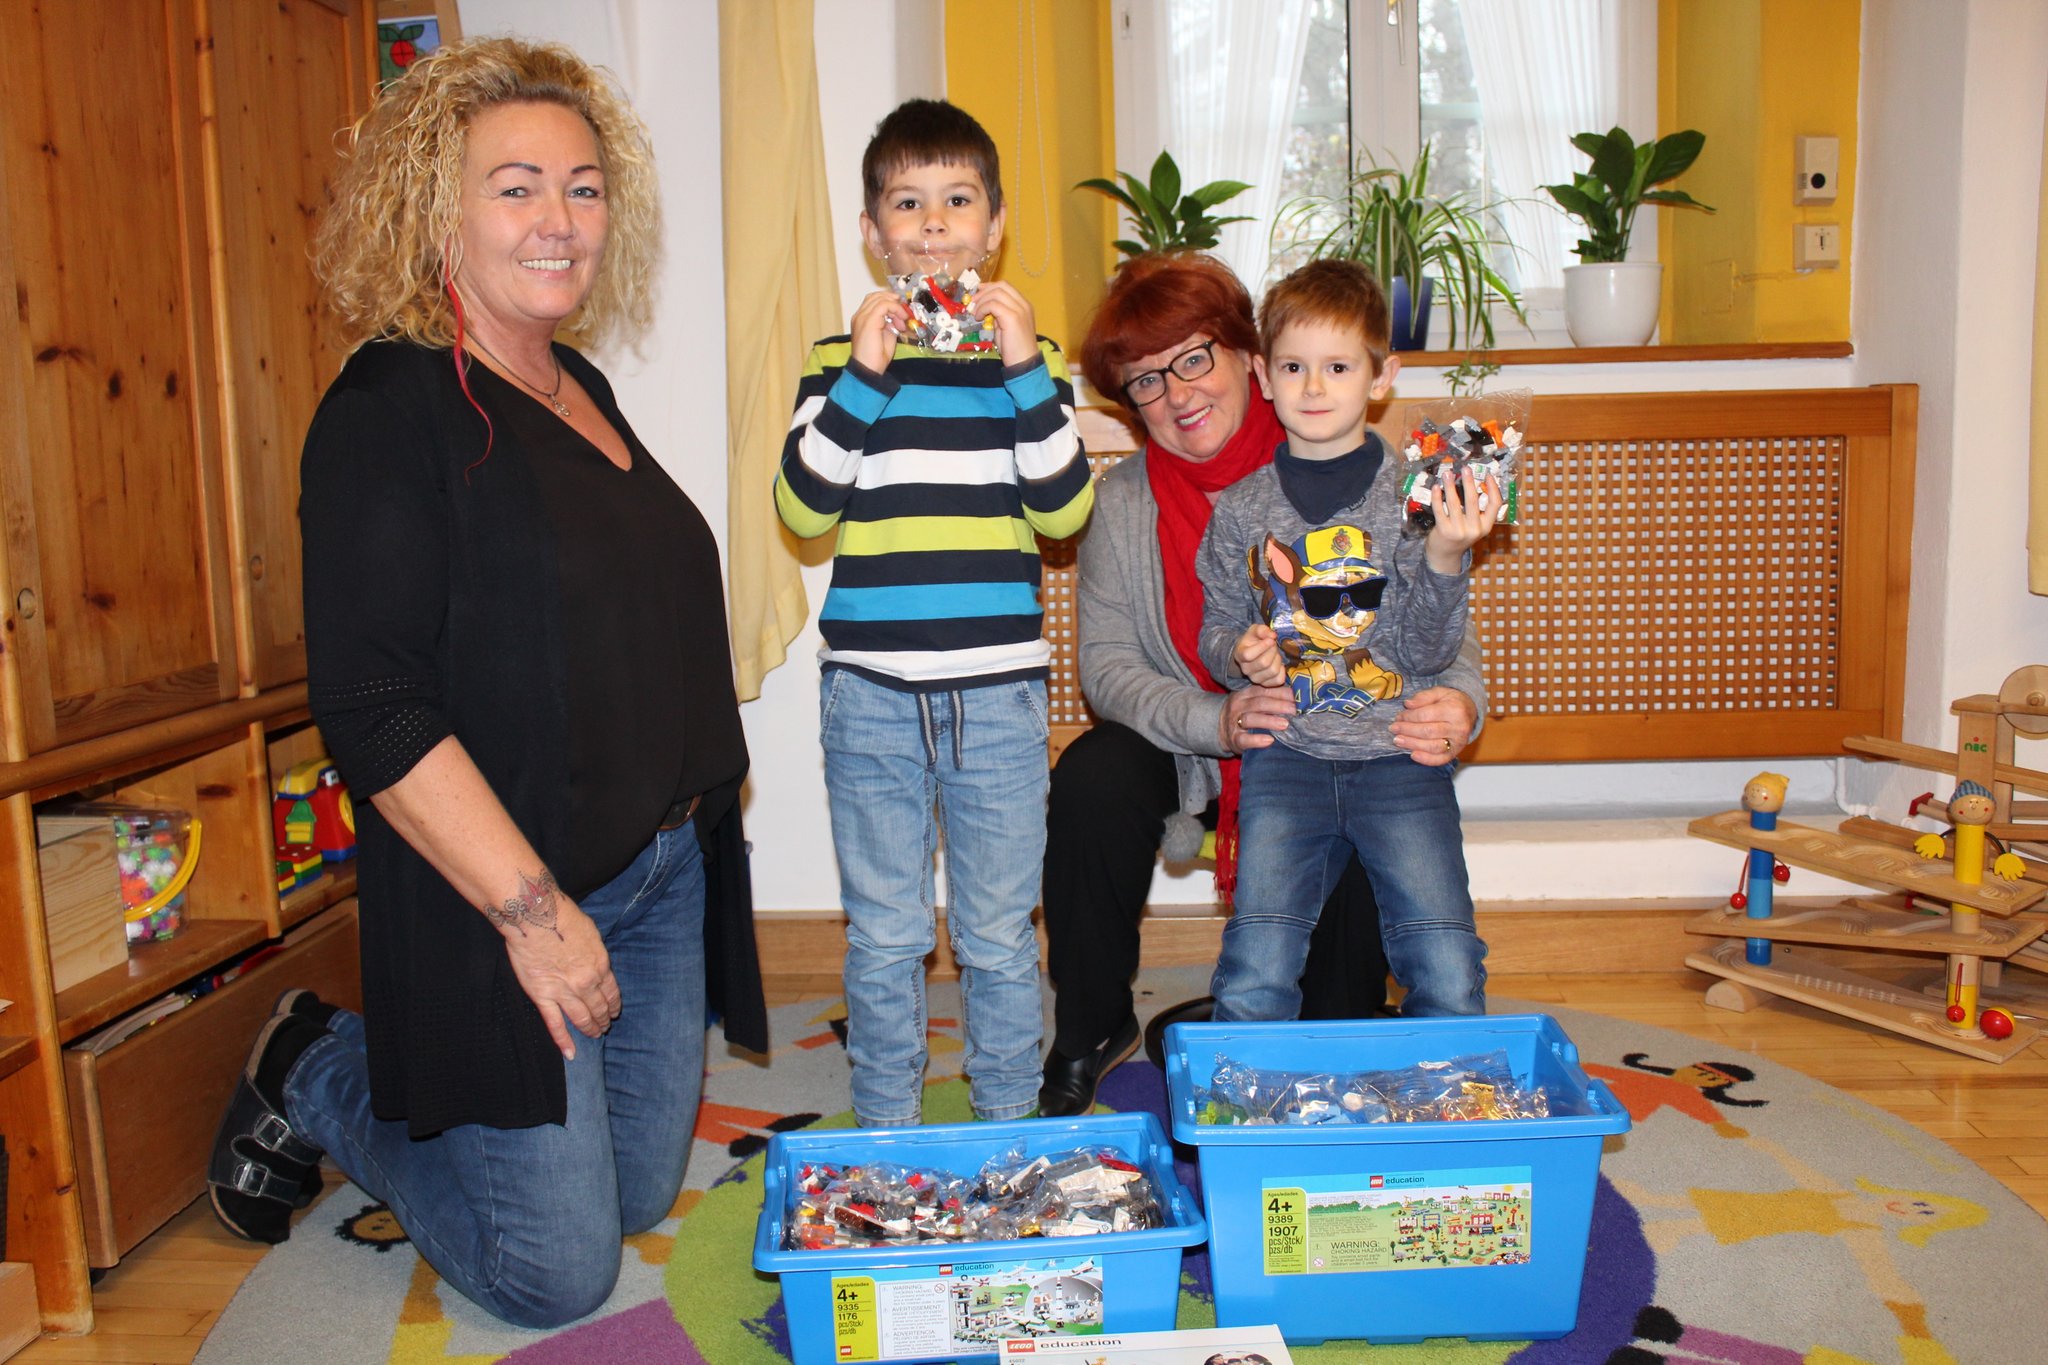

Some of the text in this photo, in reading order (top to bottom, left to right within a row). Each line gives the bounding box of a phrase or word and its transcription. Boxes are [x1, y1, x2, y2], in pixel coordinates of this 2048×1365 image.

[1287, 672, 1376, 718] ASE
[1385, 1176, 1425, 1184] education
[1268, 1198, 1292, 1213] 4+
[1268, 1215, 1293, 1223] 9389
[1269, 1226, 1298, 1236] 1907
[1269, 1236, 1303, 1247] pcs/Stck/
[1269, 1245, 1293, 1256] pzs/db
[954, 1263, 994, 1271] education
[837, 1289, 858, 1301] 4+
[838, 1312, 858, 1320] 1176
[1040, 1339, 1122, 1349] education
